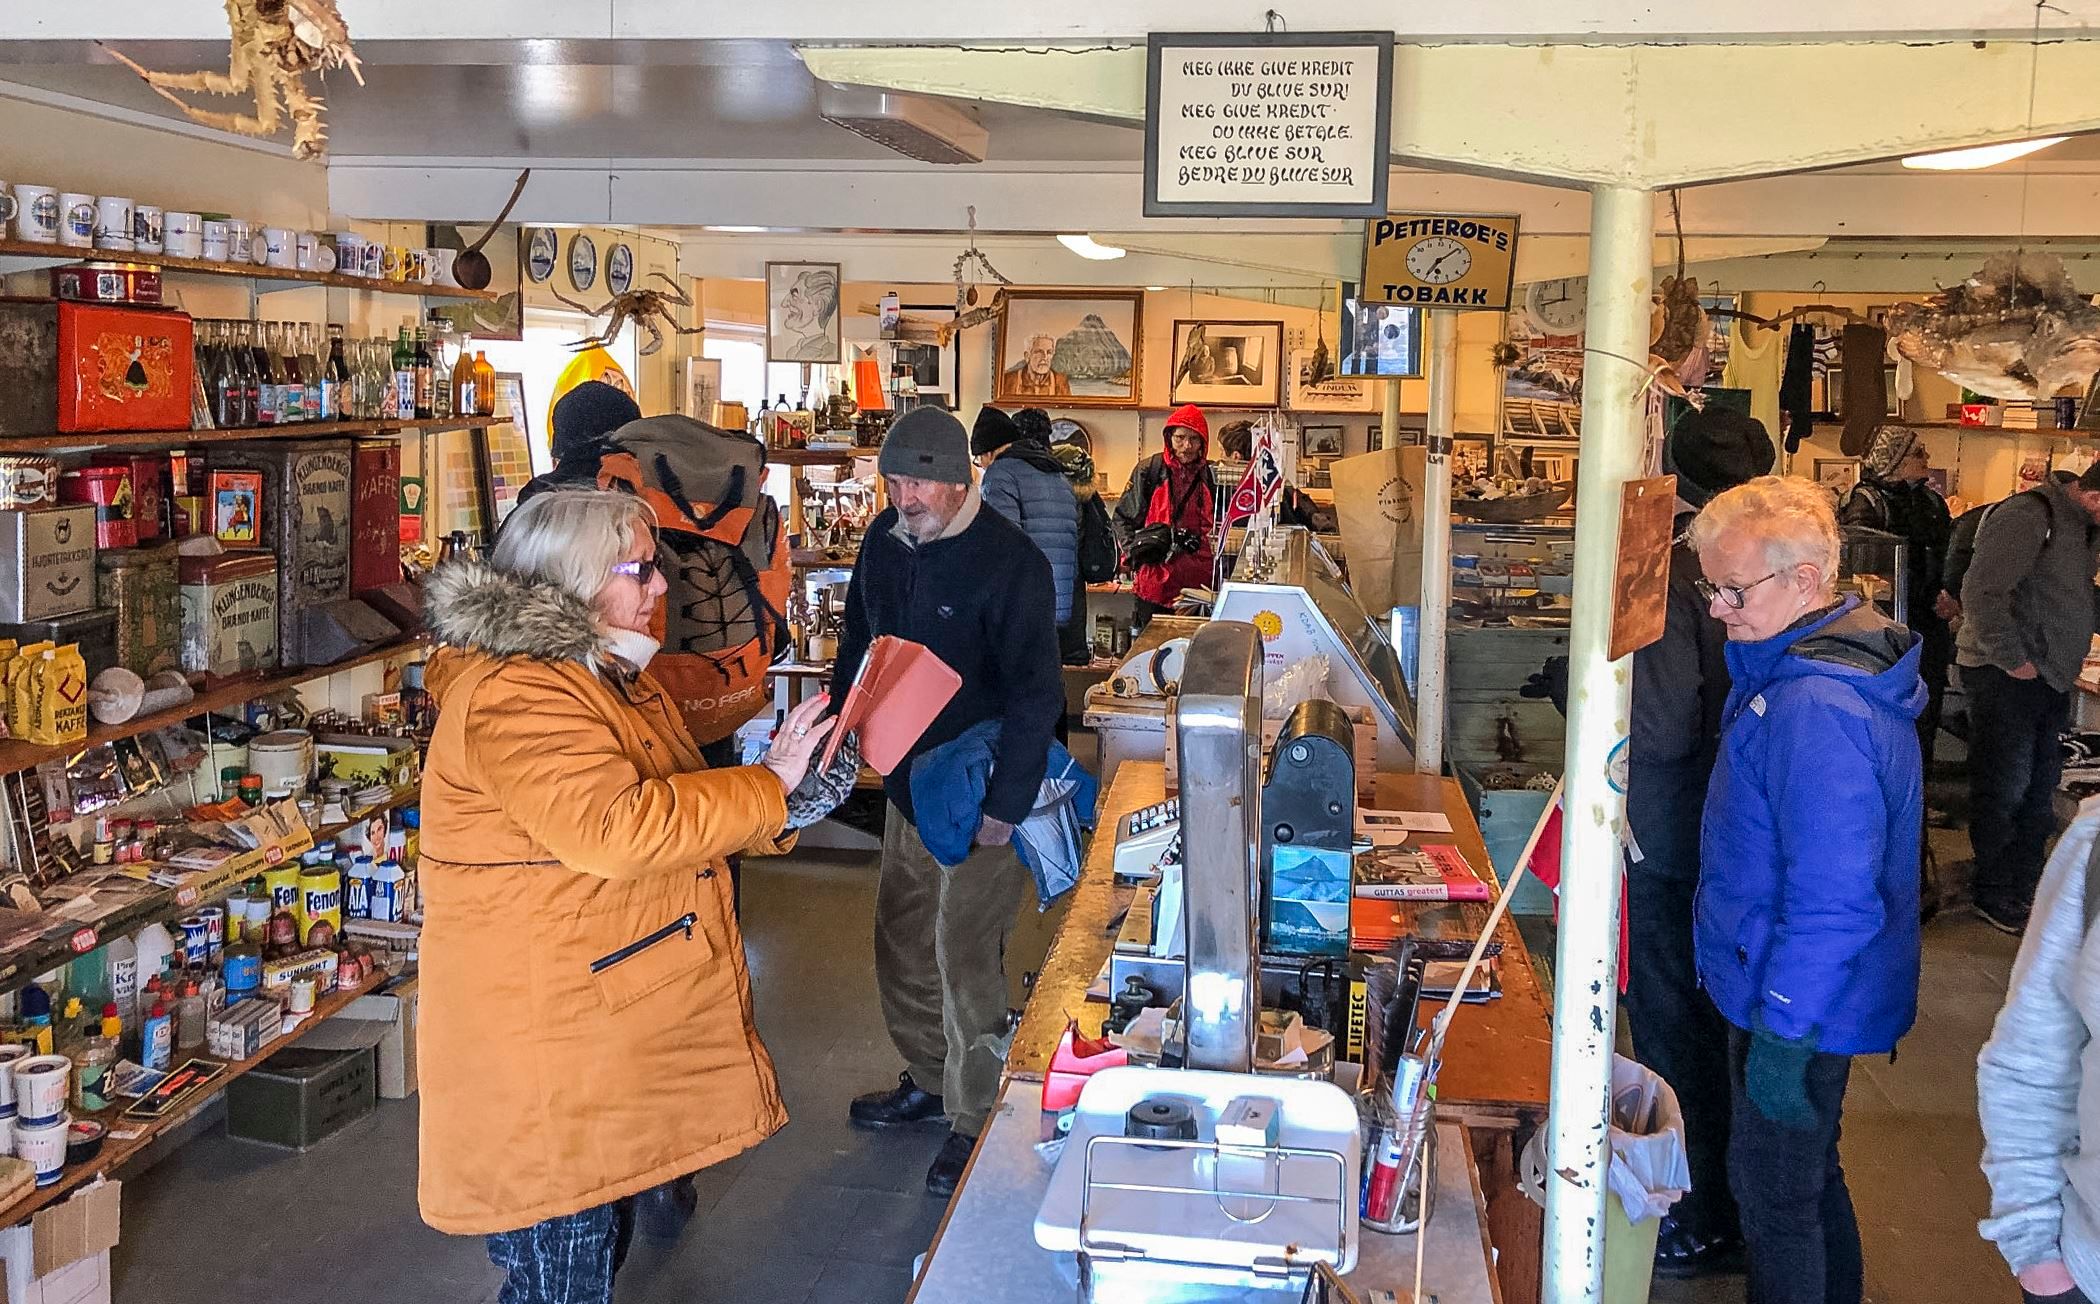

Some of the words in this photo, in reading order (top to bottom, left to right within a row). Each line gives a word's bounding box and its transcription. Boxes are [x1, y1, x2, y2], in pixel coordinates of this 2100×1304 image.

[1182, 61, 1213, 76] MEG
[1217, 61, 1255, 76] IKKE
[1261, 61, 1297, 76] GIVE
[1301, 60, 1354, 76] KREDIT
[1231, 83, 1252, 97] DU
[1257, 82, 1304, 99] BLIVE
[1309, 82, 1349, 100] SUR!
[1181, 104, 1216, 119] MEG
[1223, 104, 1261, 119] GIVE
[1238, 125, 1280, 140] IKKE
[1285, 125, 1353, 141] BETALE.
[1179, 145, 1217, 160] MEG
[1224, 145, 1279, 163] BLIVE
[1285, 146, 1325, 163] SUR
[1178, 166, 1239, 186] BEDRE
[1241, 166, 1266, 183] DU
[1269, 166, 1319, 186] BLIVE
[1321, 166, 1354, 186] SUR
[1374, 218, 1509, 252] PETTERØE'S
[1383, 284, 1488, 305] TOBAKK
[360, 475, 398, 501] KAFFE
[215, 582, 275, 617] KLINGENBERGS
[684, 698, 716, 712] NO
[1374, 889, 1405, 897] GUTTAS
[1407, 887, 1443, 897] greatest
[279, 960, 328, 981] SUNLIGHT
[1350, 993, 1365, 1047] LIFETEC
